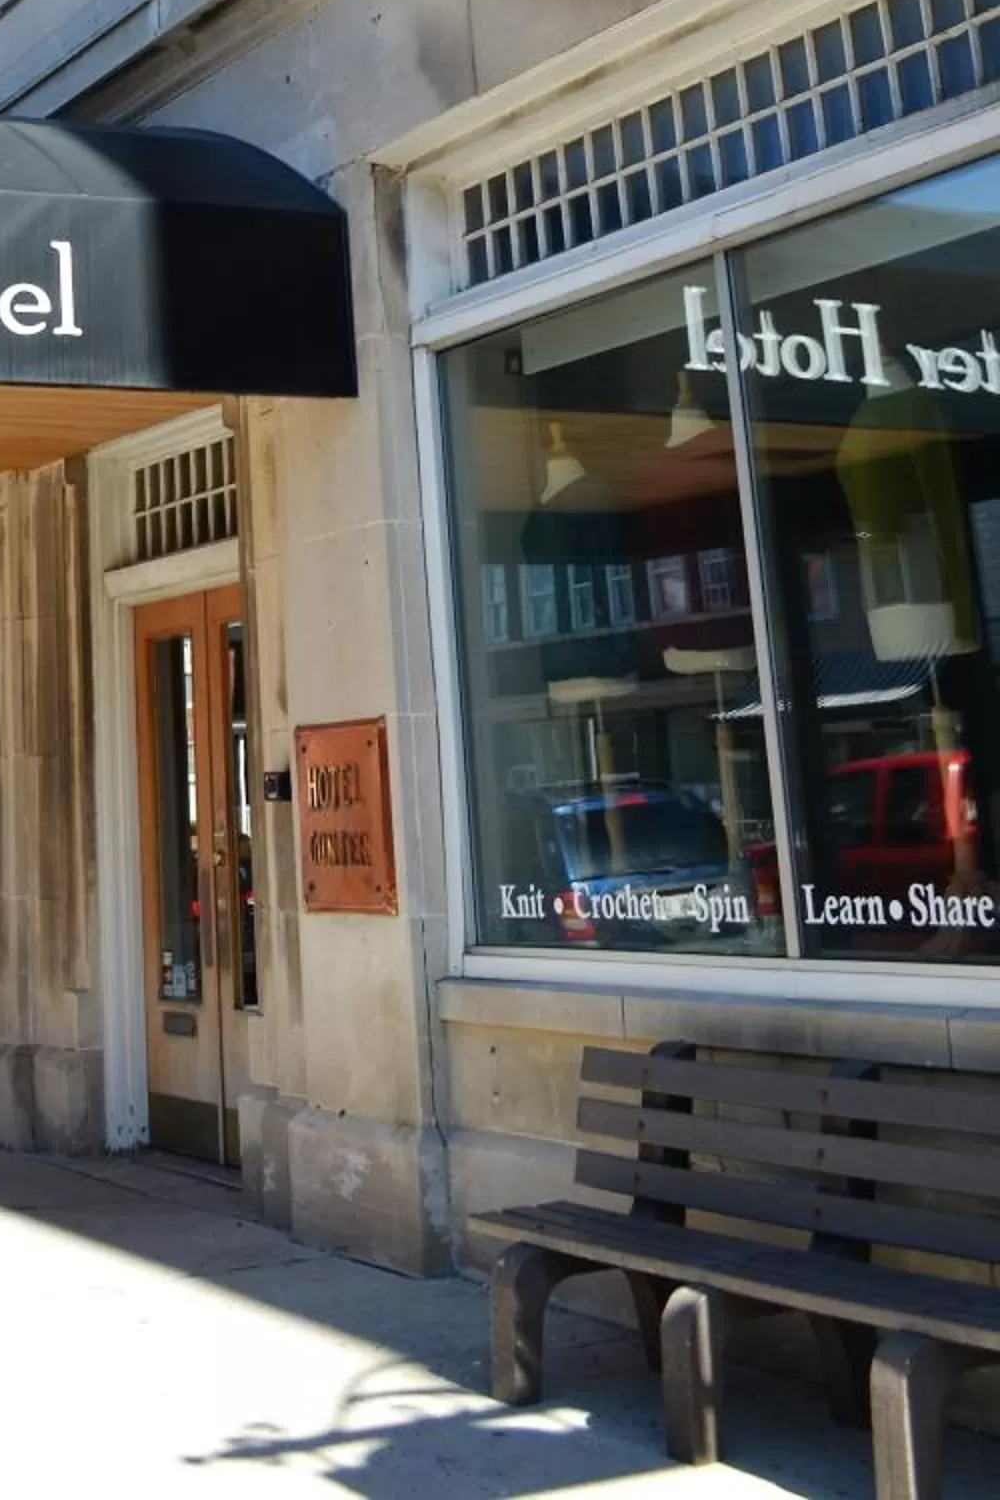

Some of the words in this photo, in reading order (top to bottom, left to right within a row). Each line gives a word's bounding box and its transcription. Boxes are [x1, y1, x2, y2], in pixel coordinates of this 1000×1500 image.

[306, 764, 365, 810] HOTEL
[499, 883, 546, 919] Knit
[571, 881, 667, 921] Crochet
[693, 883, 750, 933] Spin
[801, 883, 887, 925] Learn
[907, 882, 996, 928] Share
